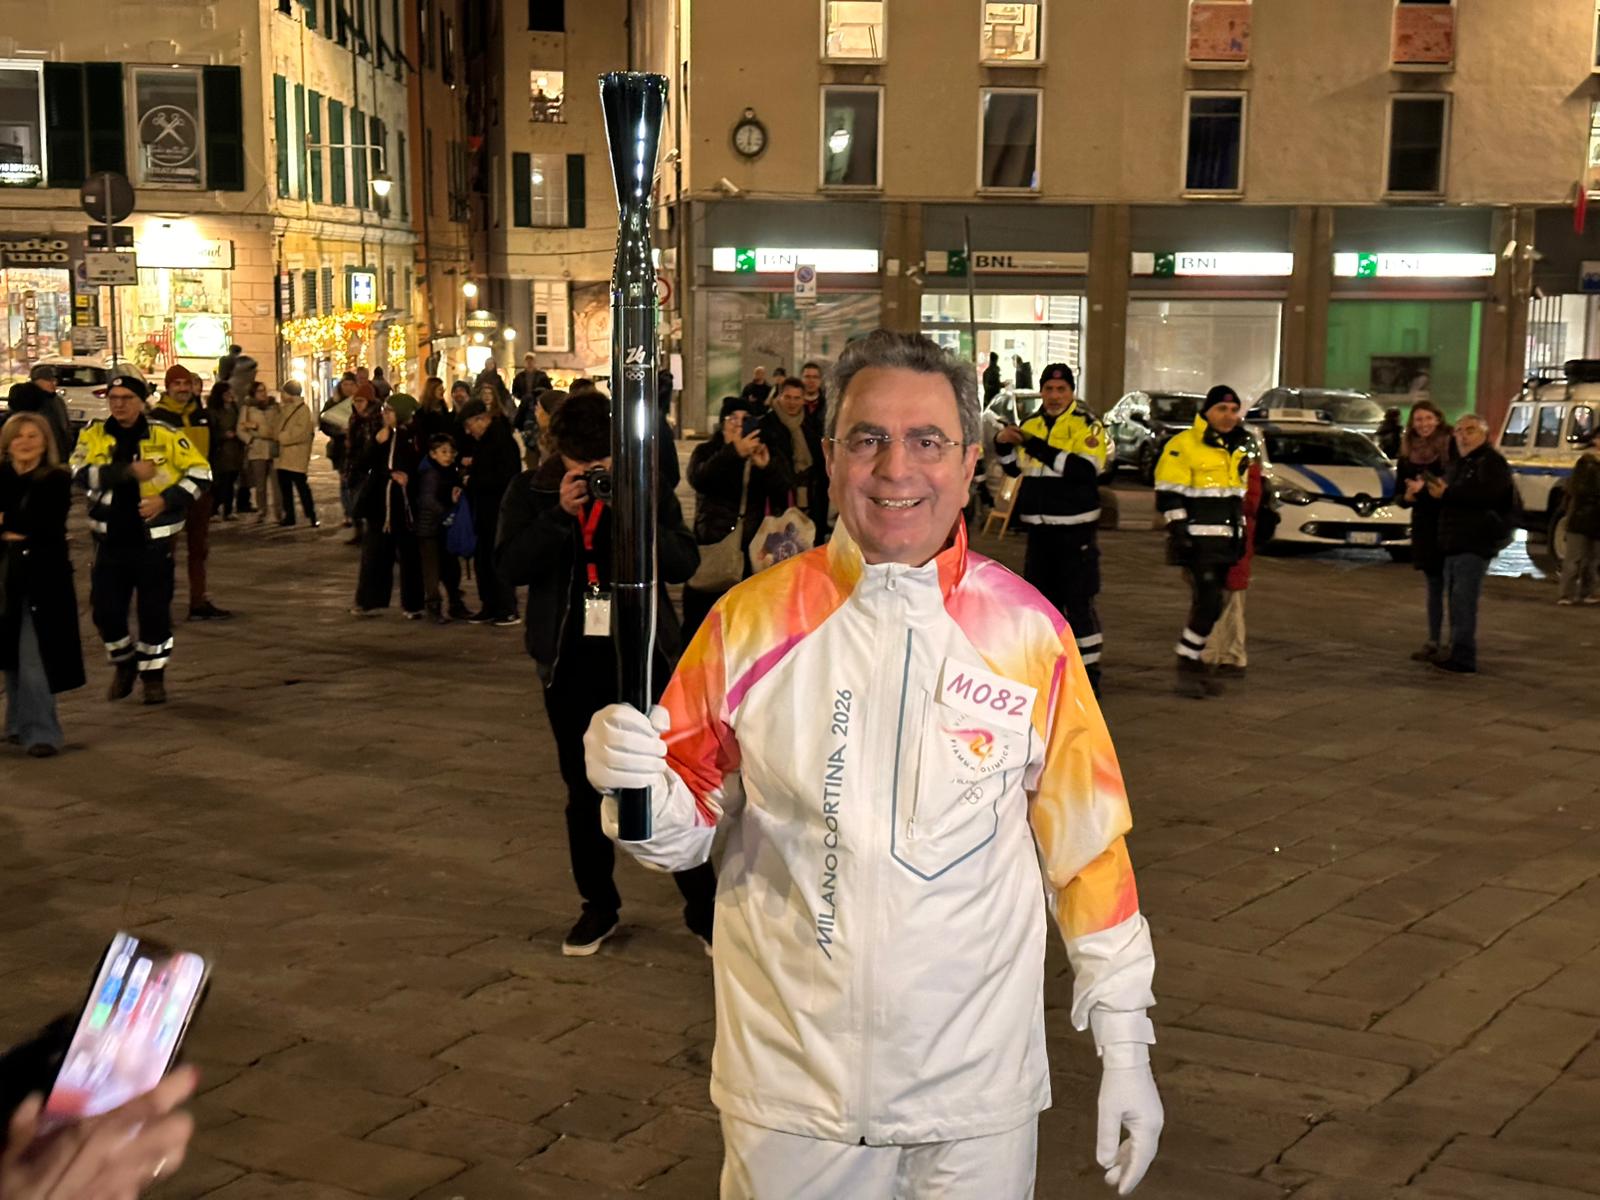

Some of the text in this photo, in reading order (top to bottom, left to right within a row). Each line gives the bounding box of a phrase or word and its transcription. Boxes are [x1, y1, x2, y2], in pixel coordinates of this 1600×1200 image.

[975, 255, 1018, 269] BNL
[946, 672, 1028, 717] M082
[980, 744, 1010, 773] OLIMPICA
[816, 689, 853, 961] MILANO CORTINA 2026
